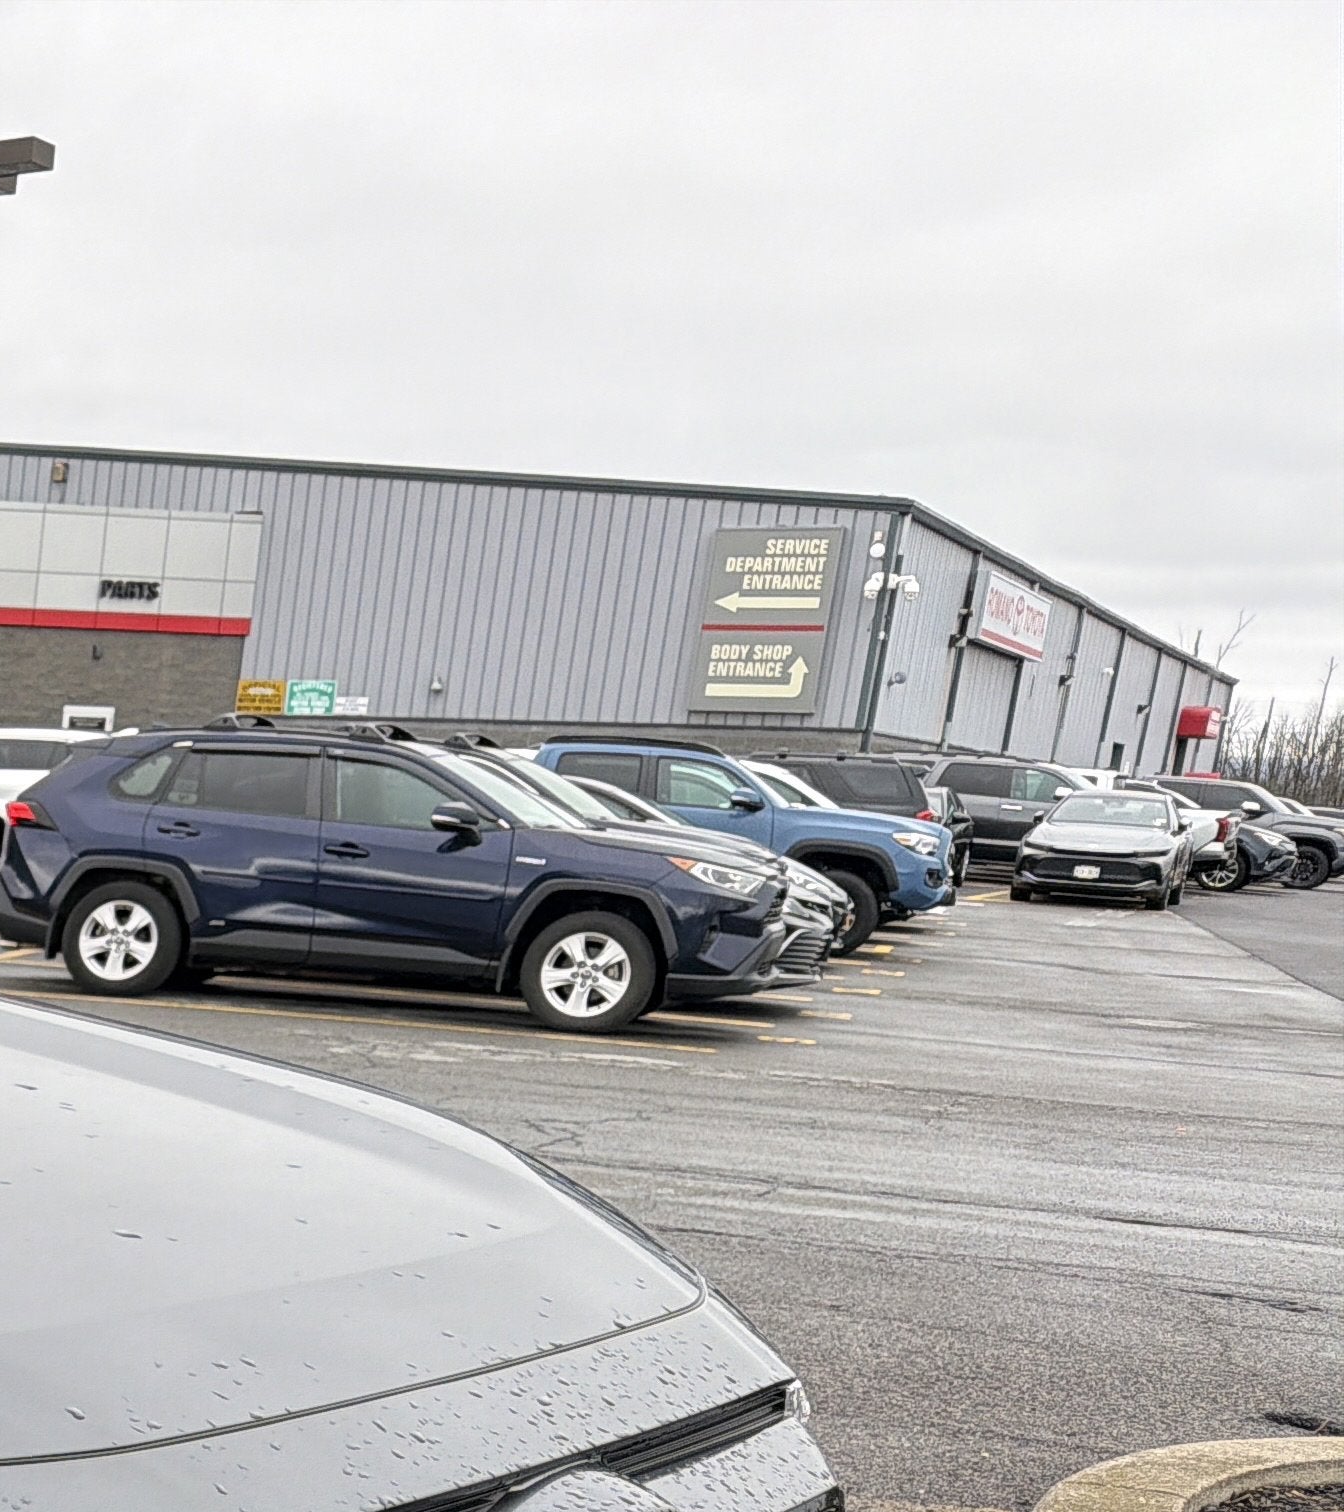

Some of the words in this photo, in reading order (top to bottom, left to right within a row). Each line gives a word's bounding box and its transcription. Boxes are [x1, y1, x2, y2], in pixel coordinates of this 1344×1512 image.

[765, 539, 830, 554] SERVICE
[725, 556, 827, 572] DEPARTMENT
[99, 579, 160, 601] PARTS
[742, 574, 823, 590] ENTRANCE
[710, 644, 750, 660] BODY
[753, 644, 792, 660] SHOP
[708, 662, 783, 677] ENTRANCE
